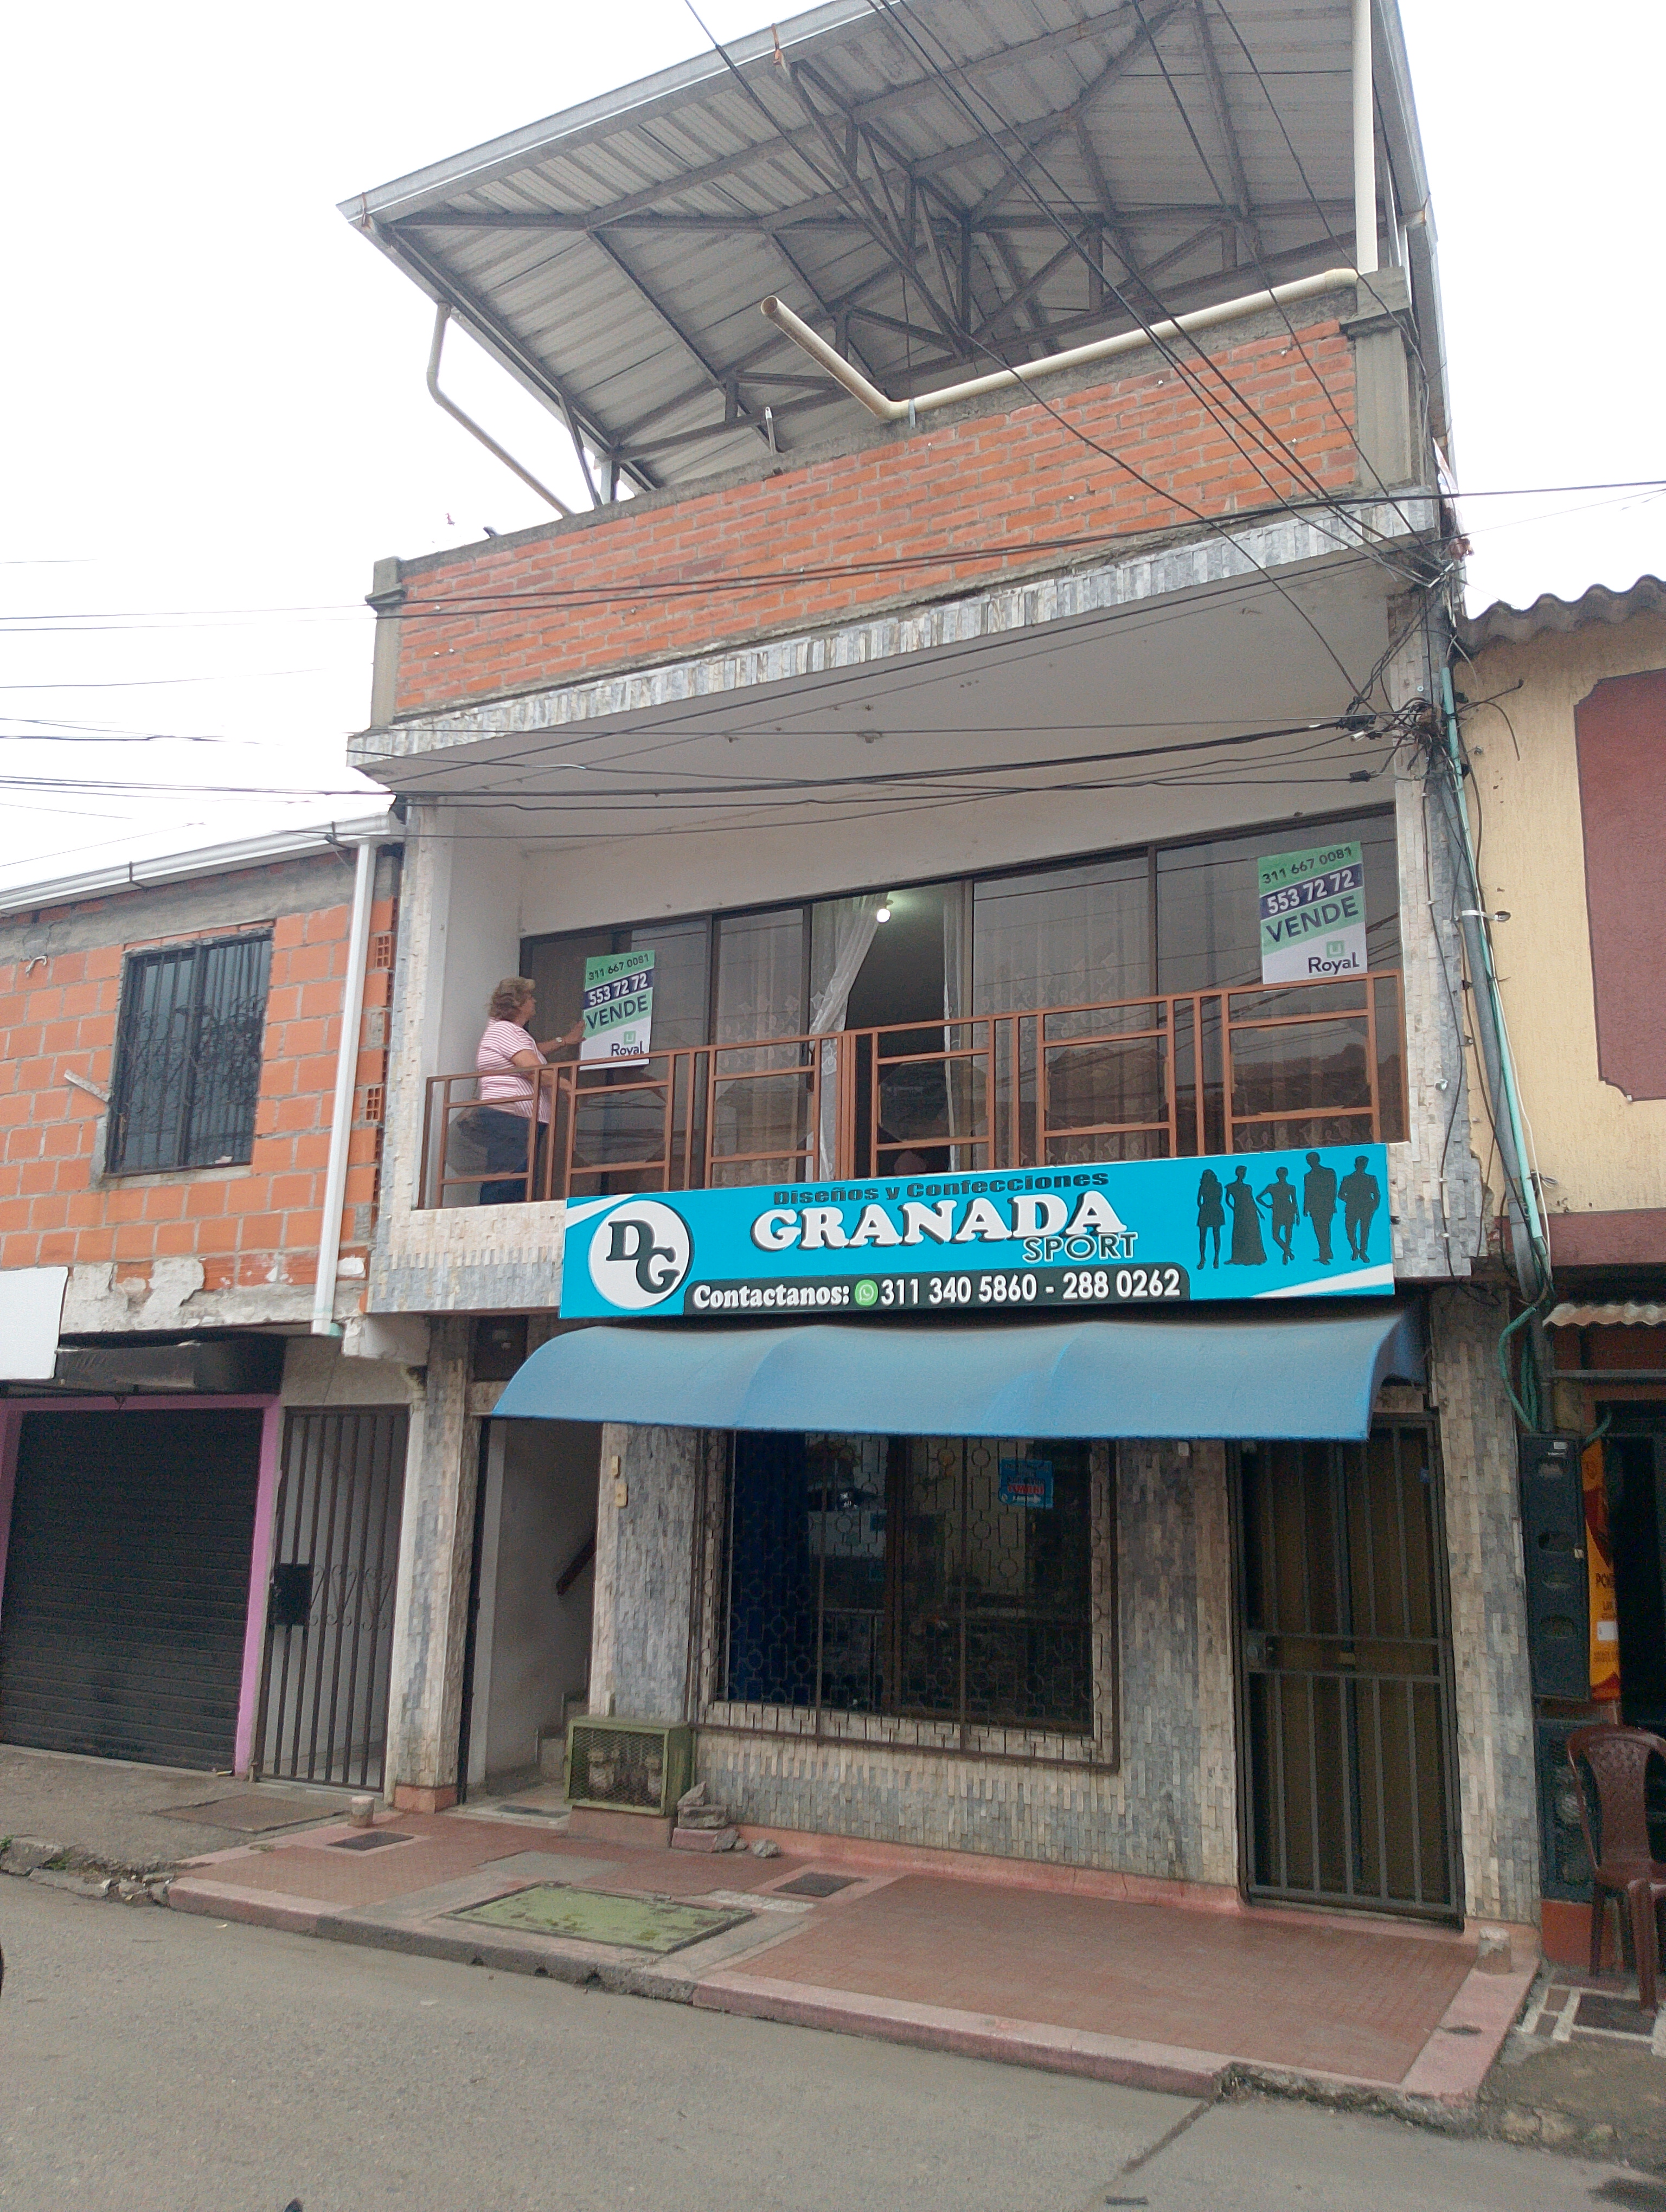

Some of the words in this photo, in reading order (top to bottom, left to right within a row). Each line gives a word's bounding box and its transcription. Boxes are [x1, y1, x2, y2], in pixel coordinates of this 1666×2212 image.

[1263, 868, 1287, 884] 311
[1291, 859, 1315, 874] 667
[1319, 846, 1351, 865] 0081
[1267, 888, 1300, 914] 553
[1303, 879, 1328, 901] 72
[1330, 870, 1355, 891] 72
[1265, 895, 1359, 943] VENDE
[588, 968, 605, 981] 311
[608, 962, 624, 974] 667
[627, 953, 649, 967] 0081
[1308, 951, 1360, 975] Royal
[588, 986, 611, 1006] 553
[613, 980, 629, 996] 72
[631, 973, 648, 991] 72
[586, 995, 648, 1030] VENDE
[611, 1040, 644, 1056] Royal
[774, 1187, 879, 1205] Diseños
[886, 1186, 900, 1199] y
[907, 1172, 1109, 1198] Confecciones
[751, 1190, 1127, 1252] GRANADA
[1022, 1232, 1138, 1263] SPORT
[693, 1284, 850, 1310] Contactanos:
[880, 1278, 919, 1306] 311
[928, 1276, 972, 1304] 340
[978, 1273, 1037, 1301] 5860
[1062, 1271, 1110, 1300] 288
[1116, 1268, 1181, 1298] 0262
